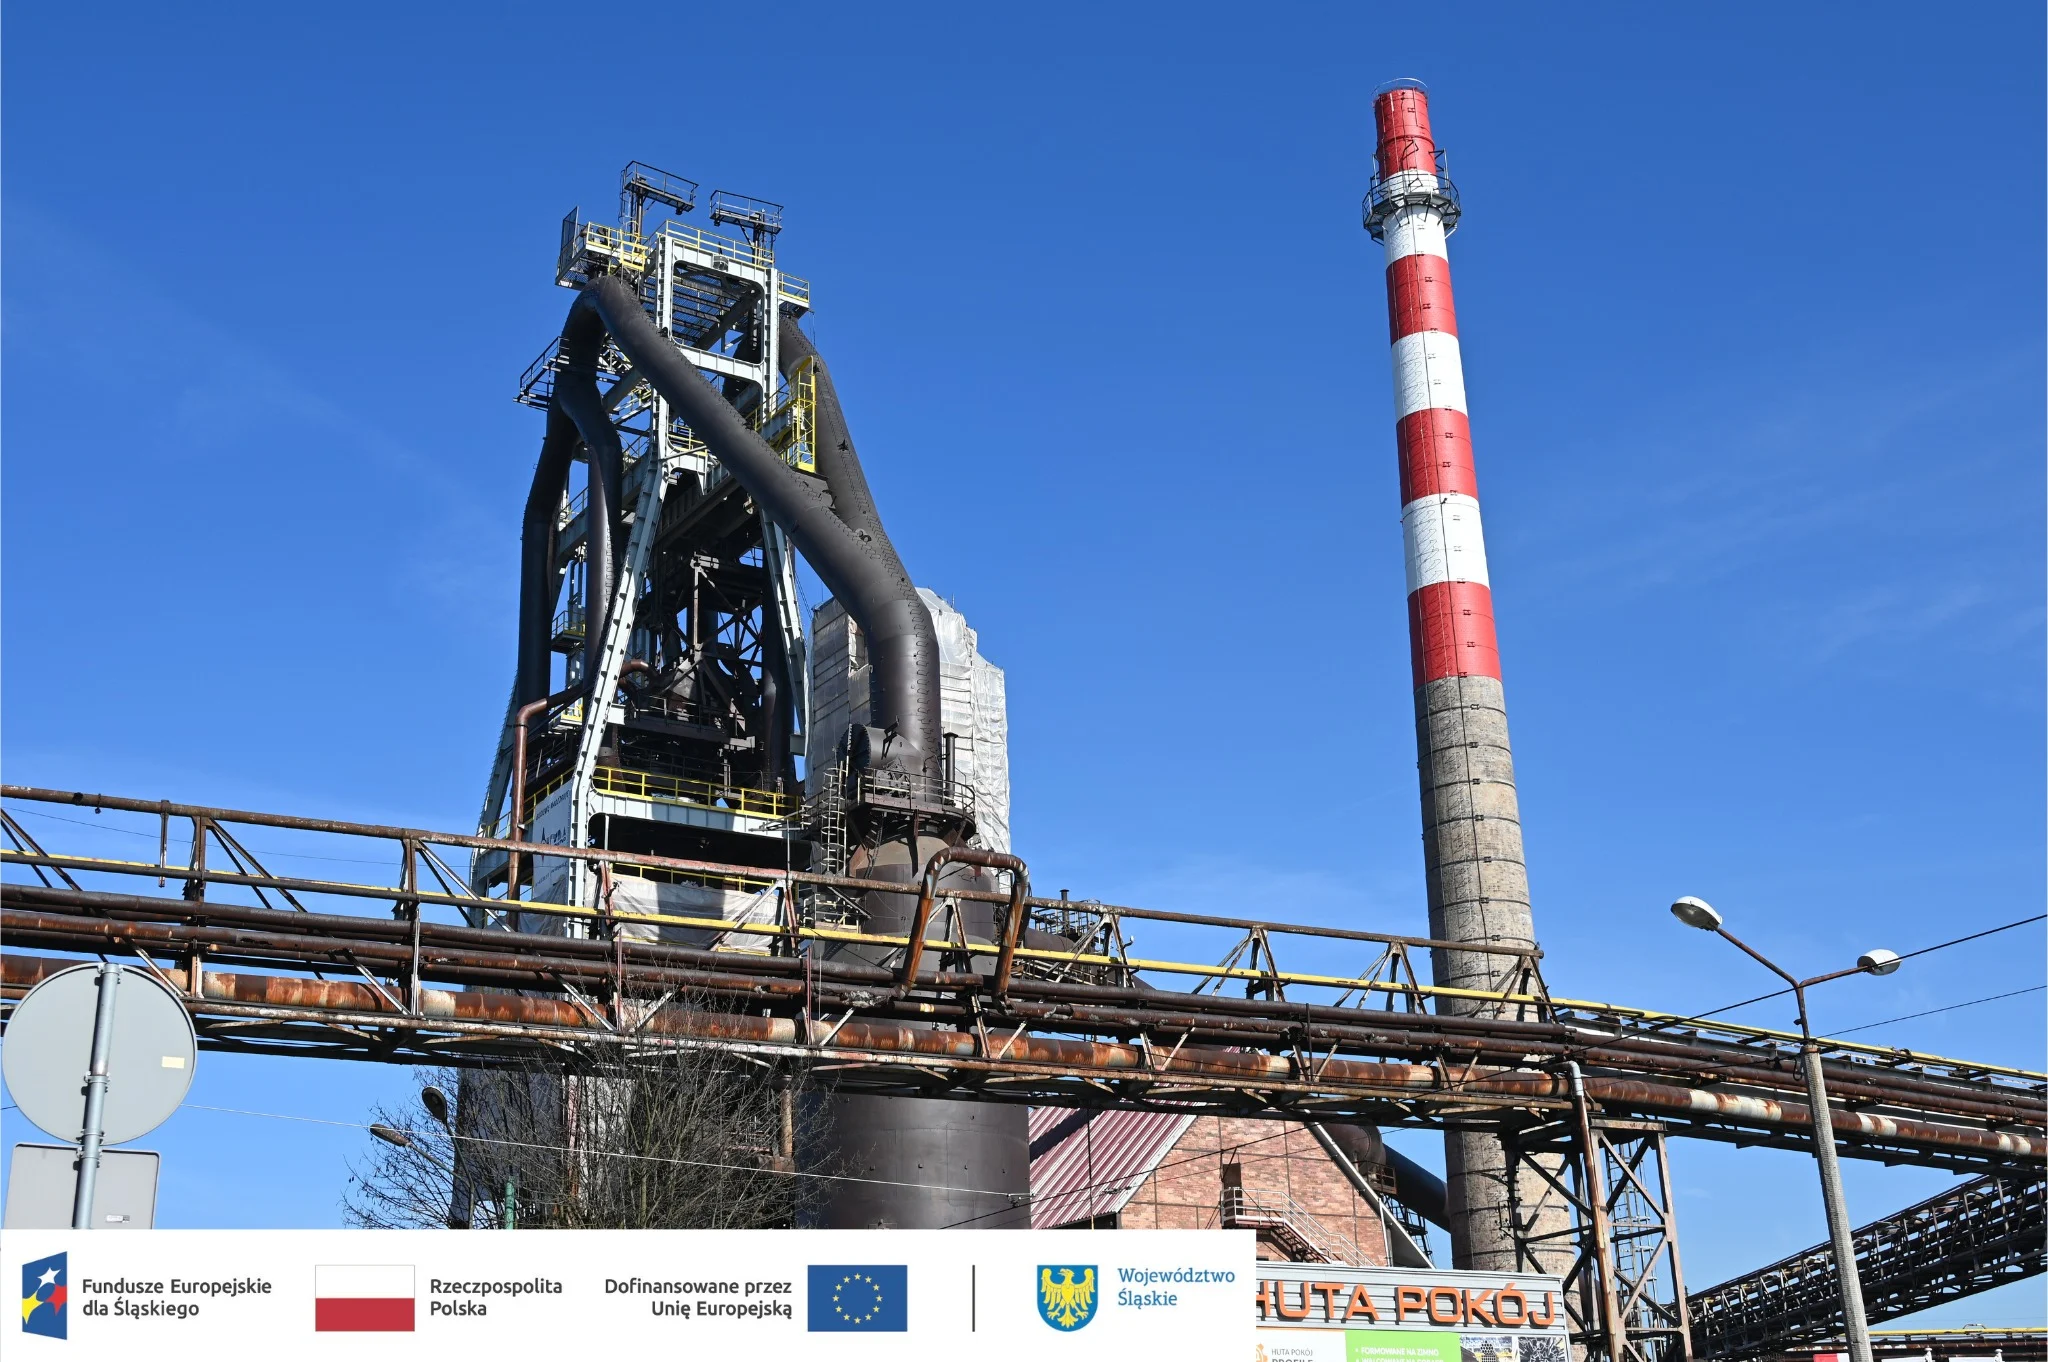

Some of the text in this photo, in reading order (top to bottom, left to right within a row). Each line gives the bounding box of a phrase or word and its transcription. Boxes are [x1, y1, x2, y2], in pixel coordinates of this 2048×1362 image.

[1396, 1282, 1555, 1326] POKÓJ
[1271, 1347, 1313, 1356] HUTA POKÓJ
[1361, 1346, 1440, 1357] FORMOWANE NA ZIMNO
